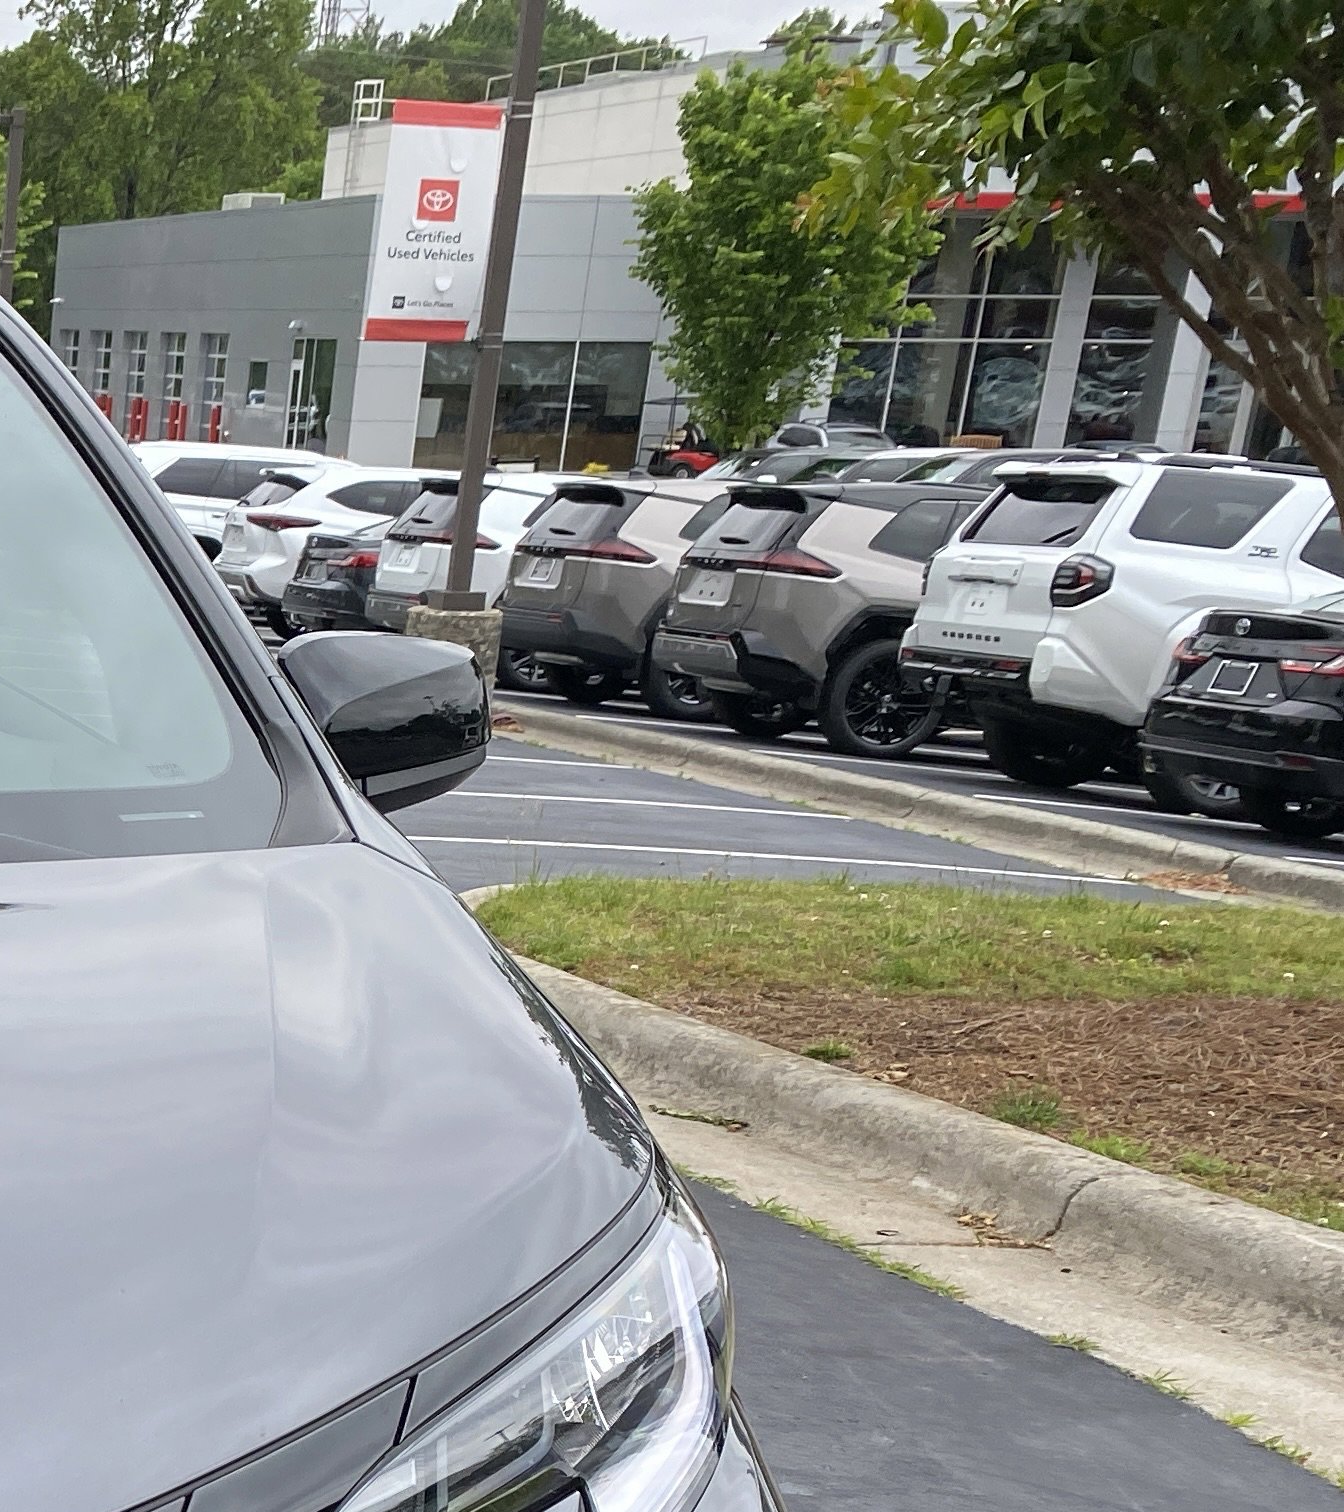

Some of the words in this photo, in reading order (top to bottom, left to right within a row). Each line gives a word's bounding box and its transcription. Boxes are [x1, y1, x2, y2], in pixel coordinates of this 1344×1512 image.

[406, 229, 462, 244] Certified
[387, 246, 420, 260] Used
[423, 248, 475, 262] Vehicles
